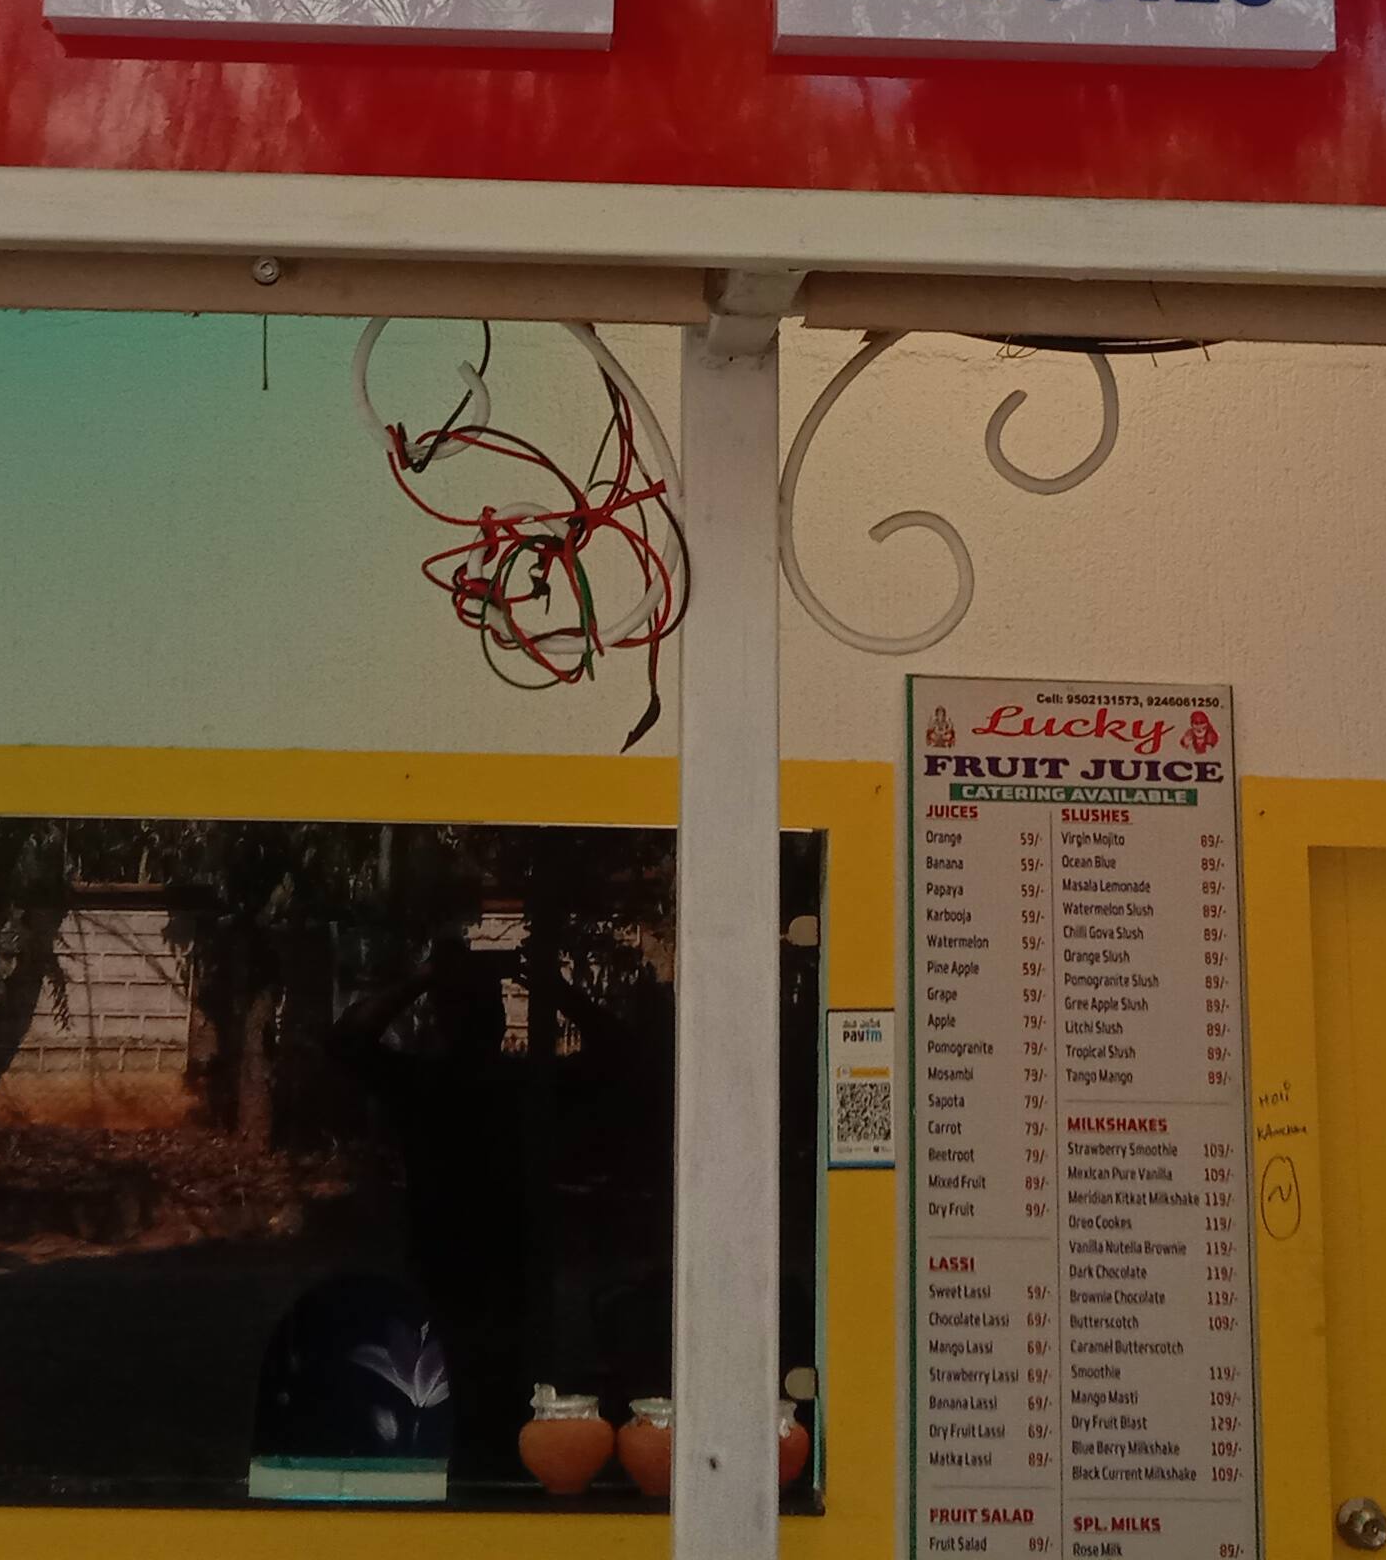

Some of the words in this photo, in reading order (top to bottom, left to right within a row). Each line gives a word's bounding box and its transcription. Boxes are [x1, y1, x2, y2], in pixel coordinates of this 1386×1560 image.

[971, 706, 1175, 755] Lucky
[924, 755, 1069, 779] FRUIT
[1080, 759, 1224, 783] JUICE
[962, 785, 1064, 801] CATERING
[1070, 788, 1187, 804] AVAILABLE
[926, 805, 978, 819] JUICES
[1062, 809, 1130, 822] SLUSHES
[926, 832, 962, 847] Orange
[926, 857, 963, 870] Banana
[1062, 856, 1093, 868] Ocean
[926, 883, 963, 898] Papaya
[927, 936, 989, 949] Watermelon
[951, 962, 979, 976] Apple
[927, 988, 957, 1001] Grape
[928, 1014, 956, 1028] Apple
[928, 1094, 965, 1109] Sapota
[1068, 1118, 1167, 1132] MILKSHAKES
[929, 1257, 975, 1270] LASSI
[930, 1509, 978, 1523] FRUIT
[981, 1510, 1034, 1523] SALAD
[1073, 1517, 1107, 1531] SPL.
[1111, 1518, 1161, 1532] MILKS
